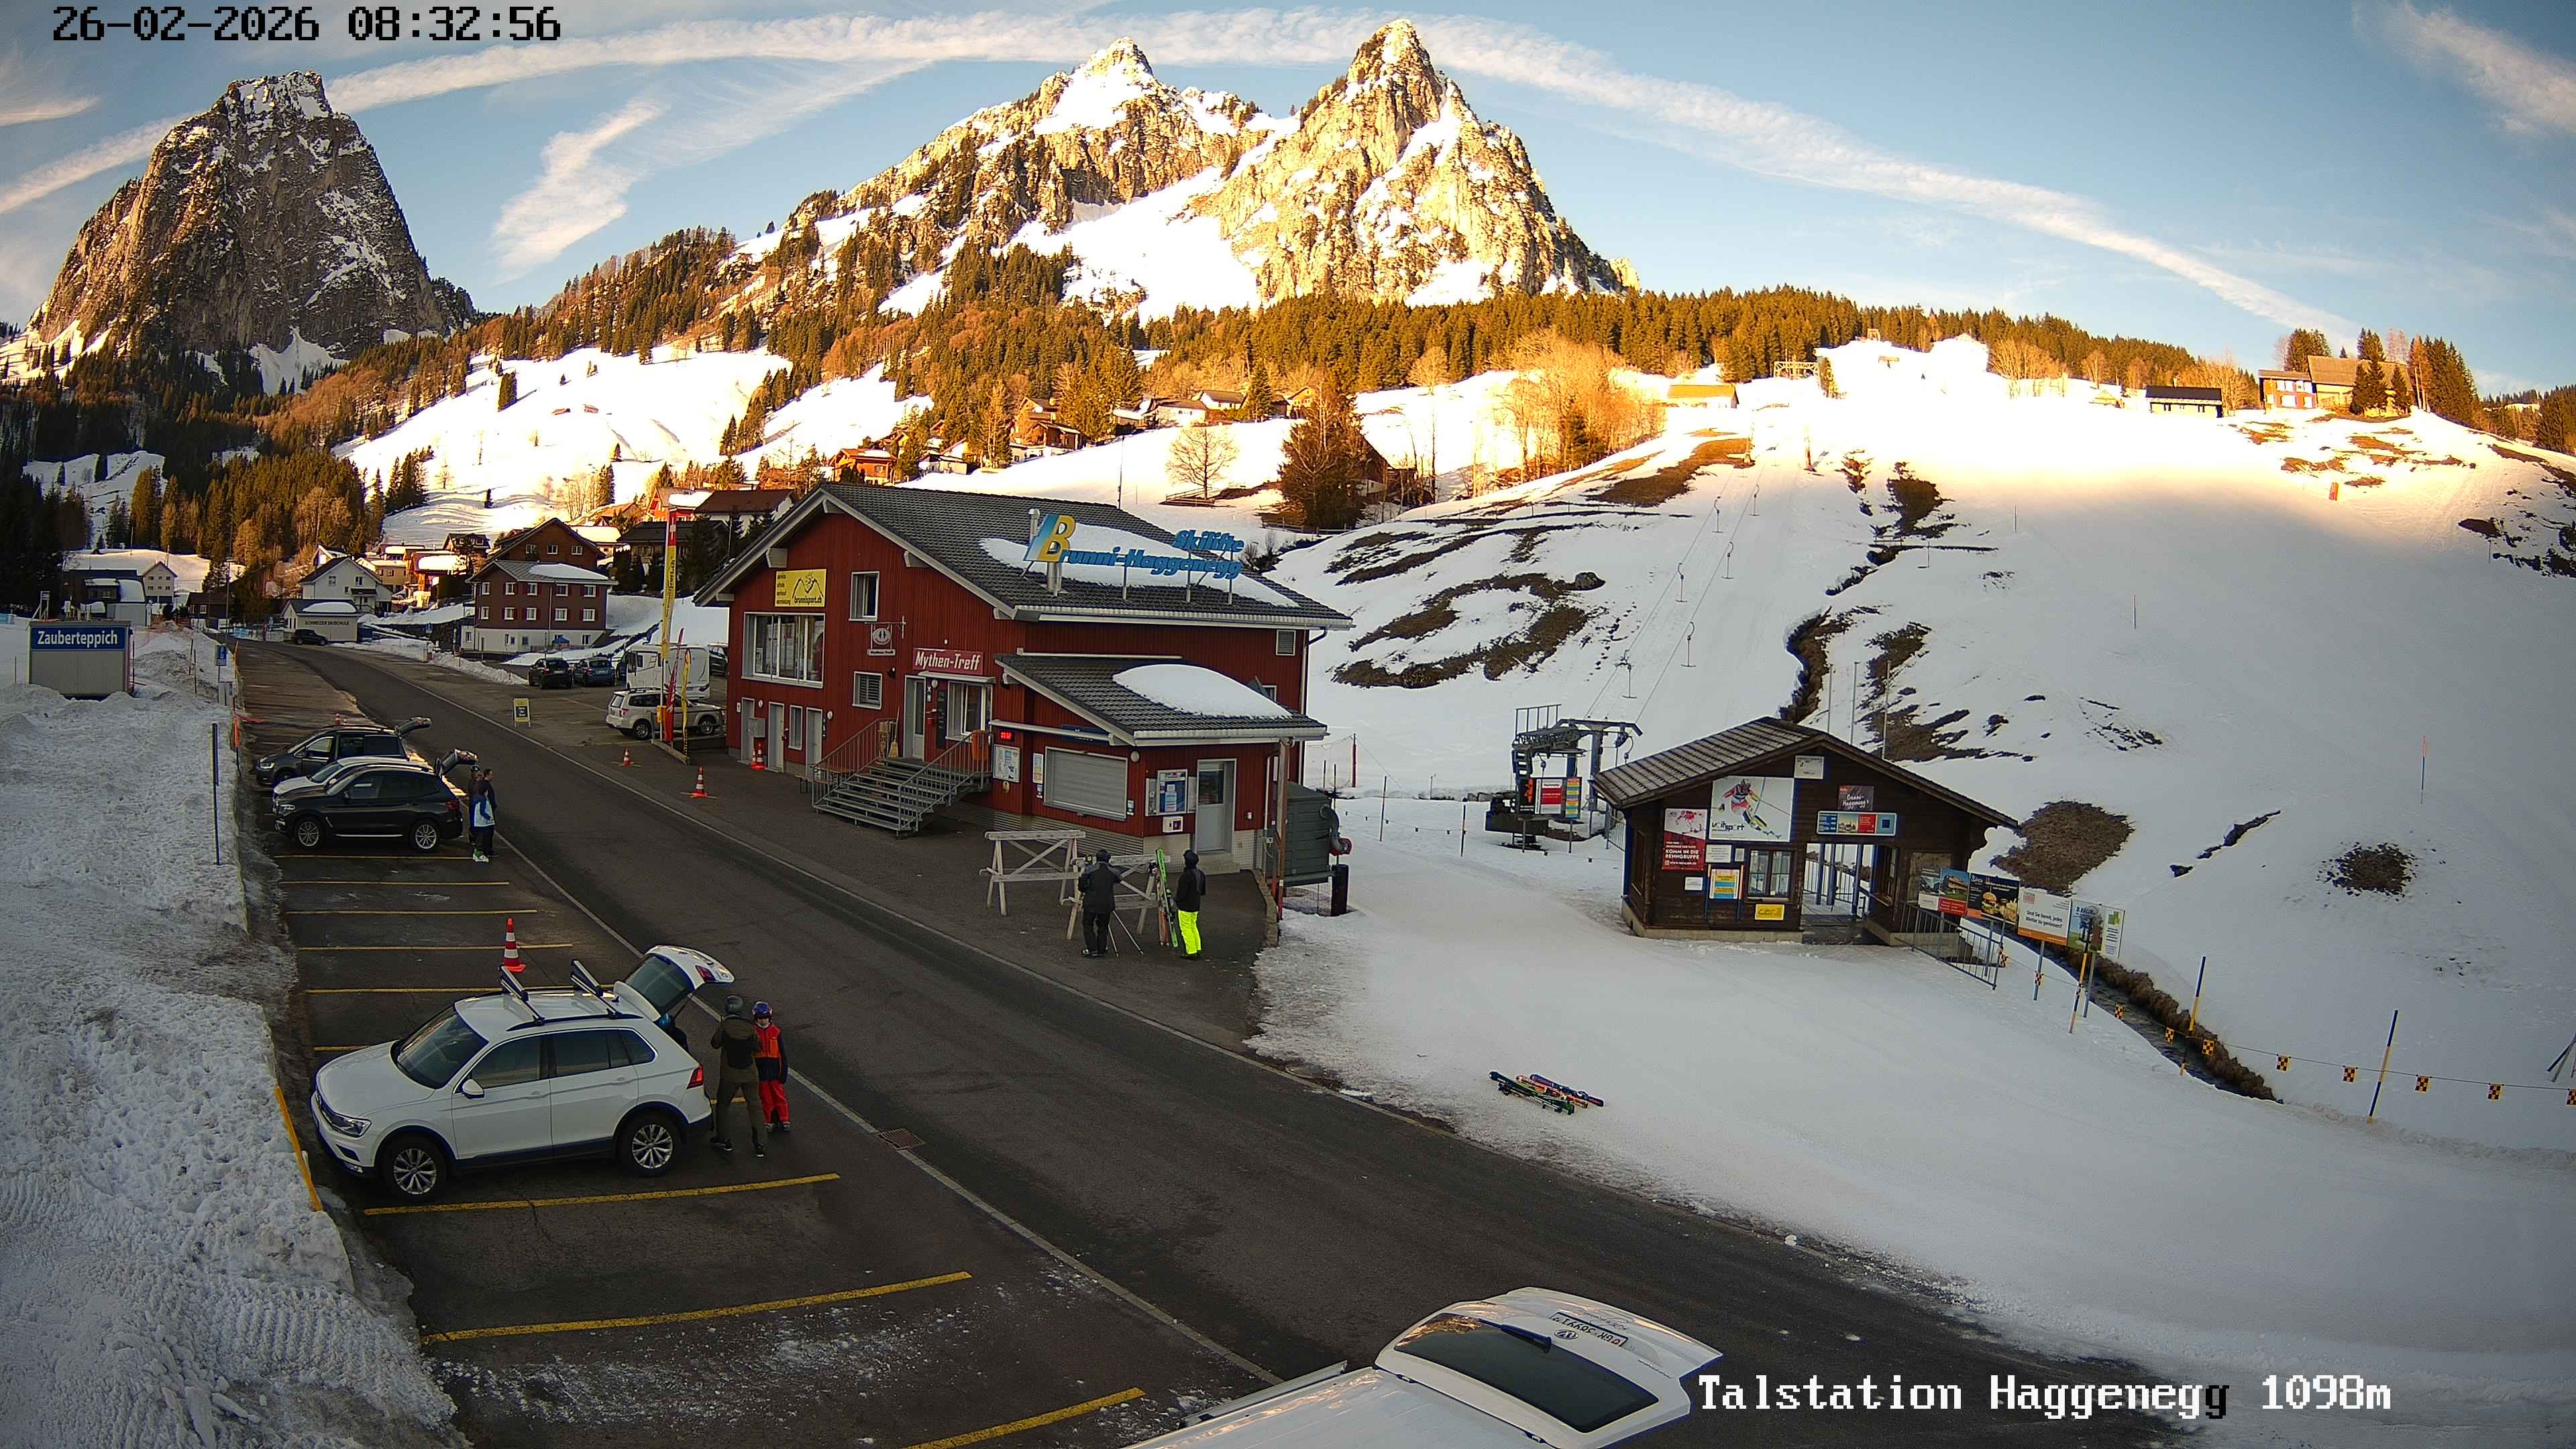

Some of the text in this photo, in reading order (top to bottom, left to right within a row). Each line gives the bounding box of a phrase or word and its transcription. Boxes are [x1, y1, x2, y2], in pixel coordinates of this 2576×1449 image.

[1023, 513, 1242, 579] Brunni-Haggenegg
[1174, 529, 1245, 552] Skilifte
[37, 630, 118, 648] Zauberteppich
[915, 651, 981, 670] Mythen-Treff
